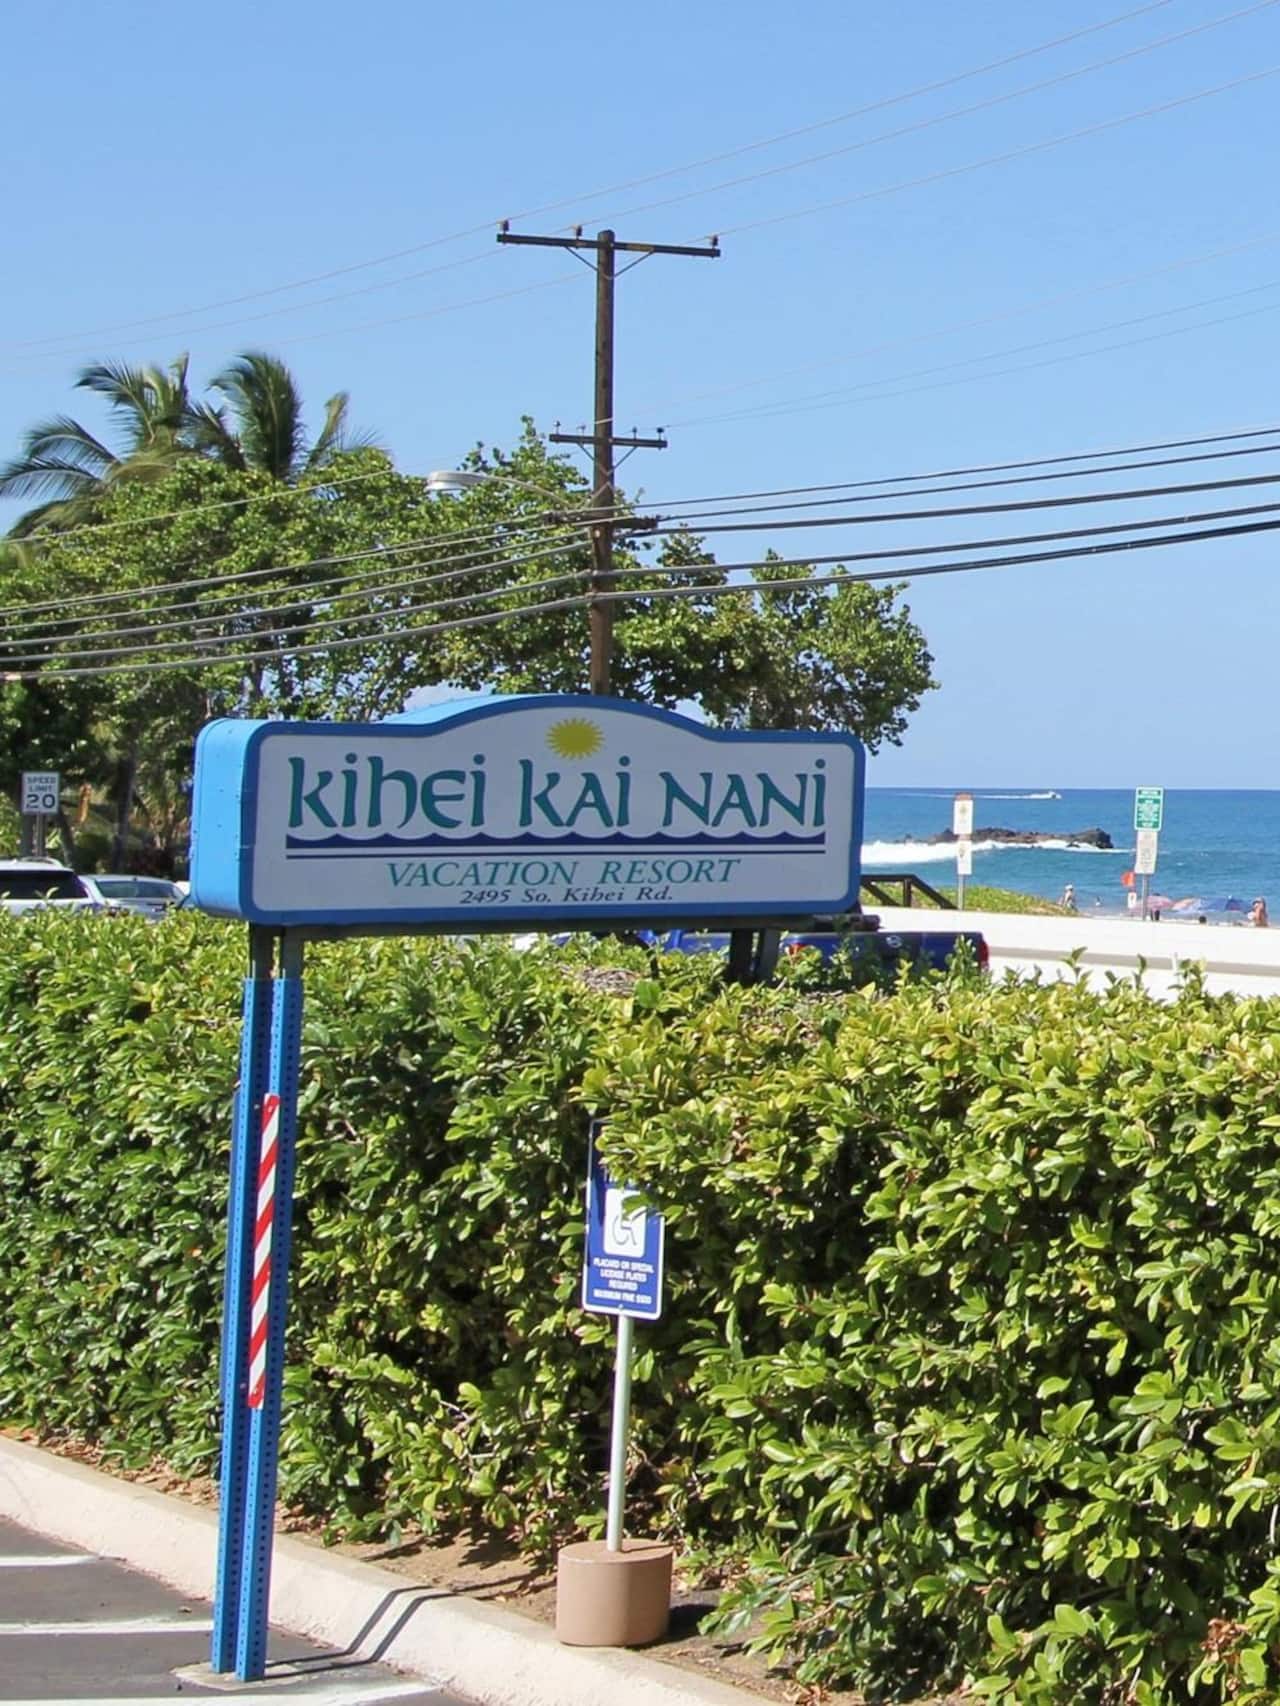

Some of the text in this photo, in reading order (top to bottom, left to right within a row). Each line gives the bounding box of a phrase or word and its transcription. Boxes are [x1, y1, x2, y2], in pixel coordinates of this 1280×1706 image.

[26, 776, 56, 784] SPEED
[28, 785, 52, 793] LIMIT
[26, 793, 56, 809] 20
[386, 858, 741, 887] VACATION RESORT
[460, 886, 673, 904] 2495 So. Kihei Rd.
